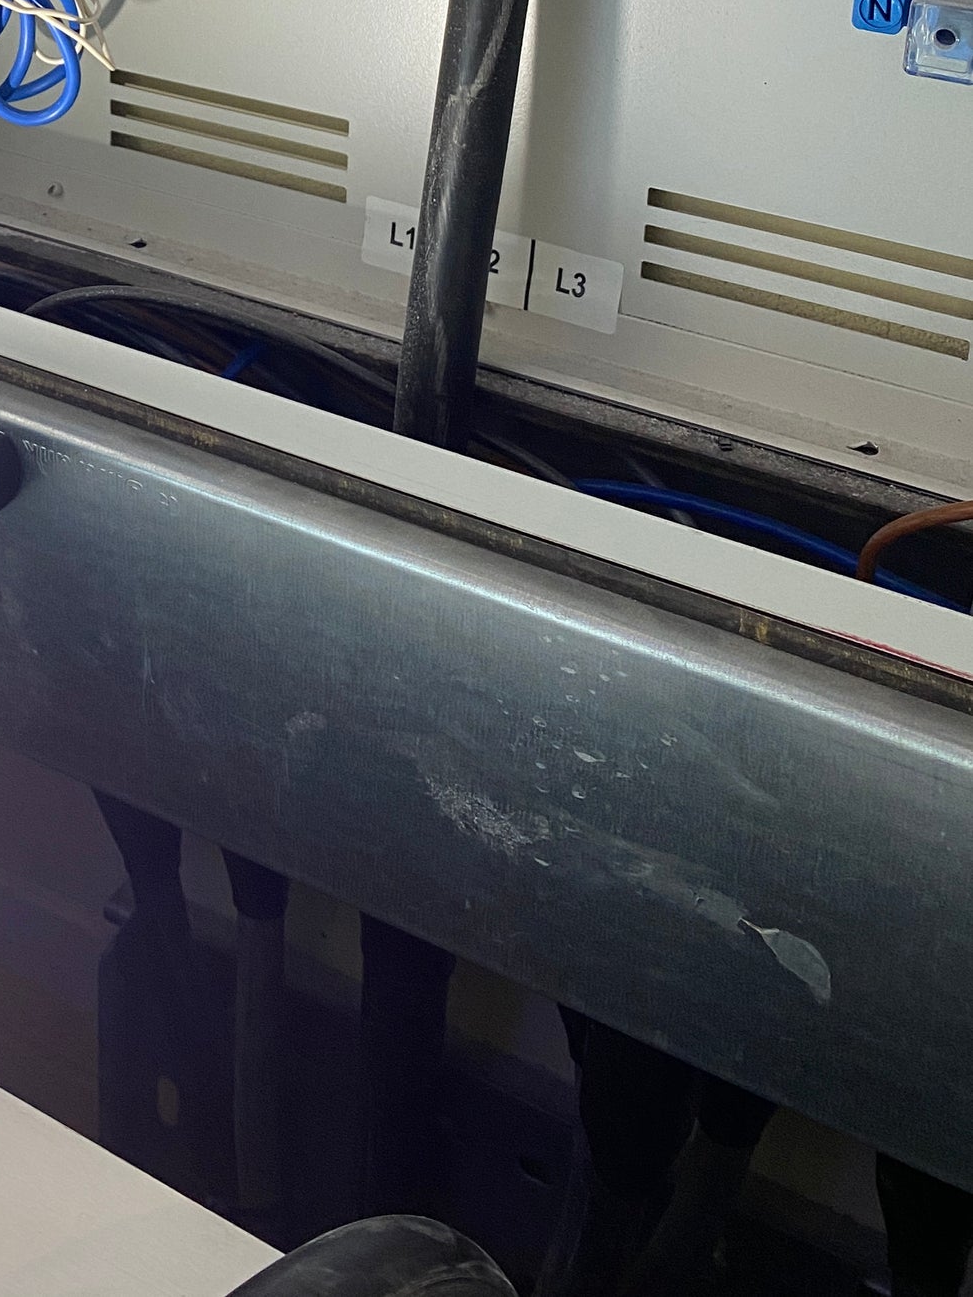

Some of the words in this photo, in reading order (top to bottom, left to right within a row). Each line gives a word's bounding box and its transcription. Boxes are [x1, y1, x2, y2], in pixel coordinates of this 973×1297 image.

[390, 222, 415, 250] L1
[488, 250, 500, 273] 2
[556, 268, 587, 299] L3
